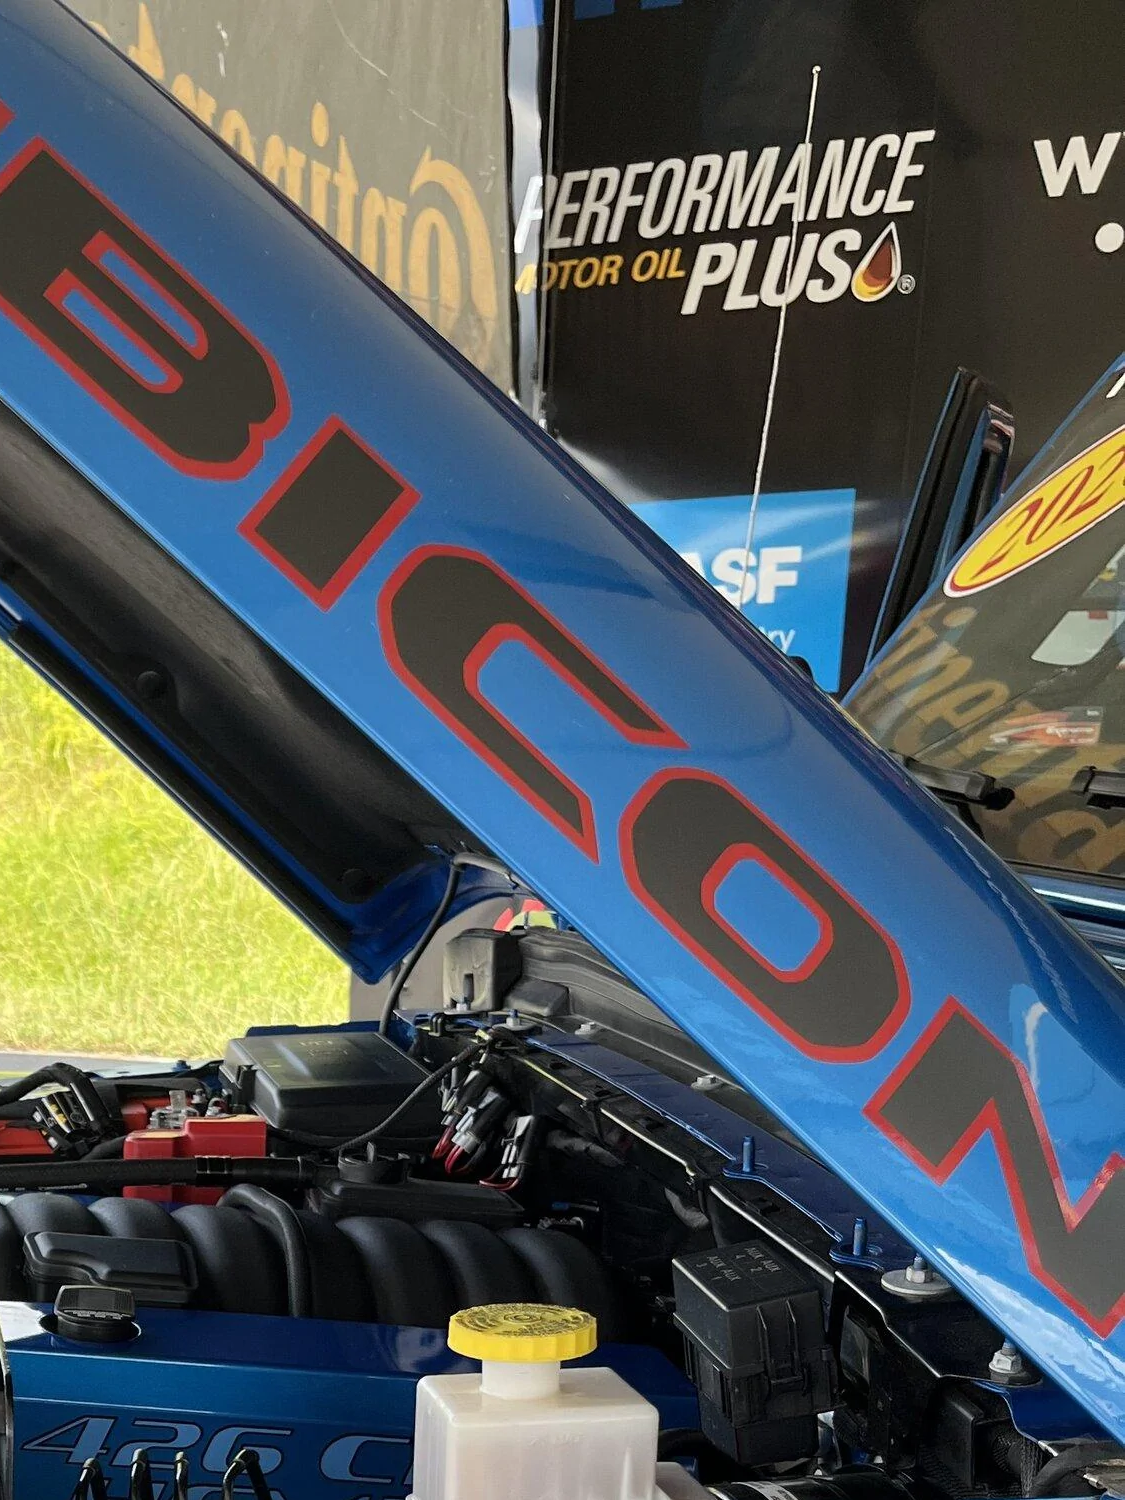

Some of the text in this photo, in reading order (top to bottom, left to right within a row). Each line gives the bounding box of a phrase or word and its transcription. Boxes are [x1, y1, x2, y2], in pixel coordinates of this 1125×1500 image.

[513, 129, 936, 254] PERFORMANCE
[631, 246, 686, 283] OIL
[680, 228, 863, 316] PLUS
[22, 1414, 293, 1478] 426
